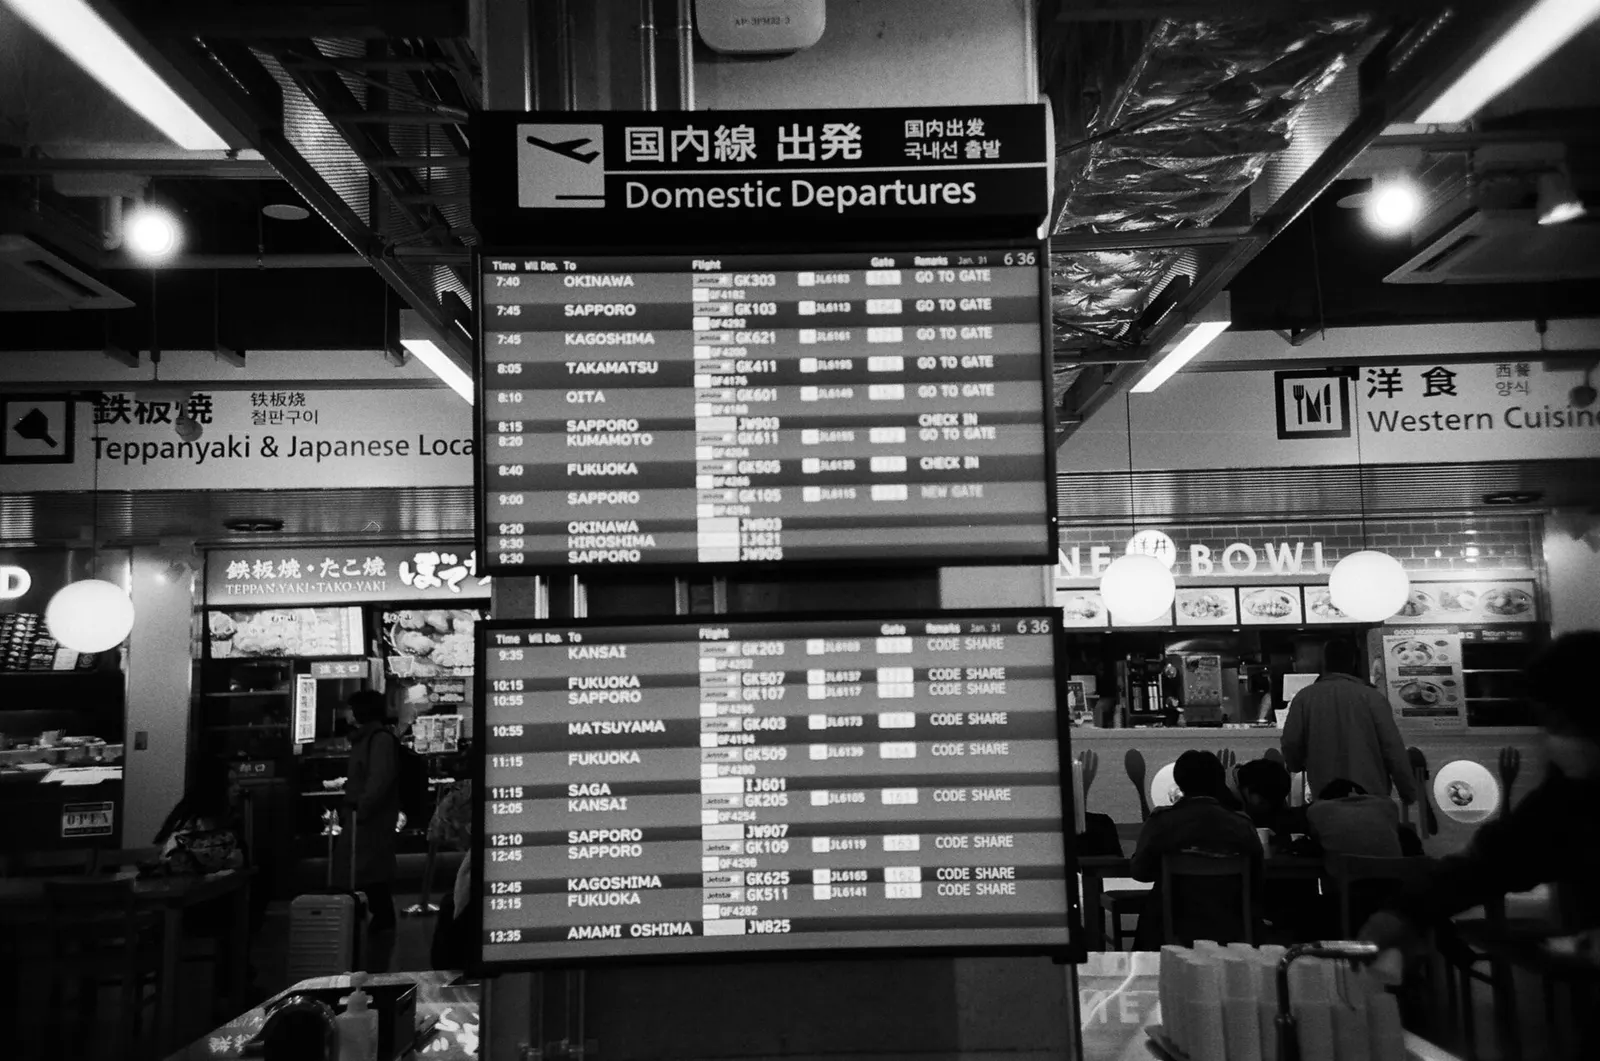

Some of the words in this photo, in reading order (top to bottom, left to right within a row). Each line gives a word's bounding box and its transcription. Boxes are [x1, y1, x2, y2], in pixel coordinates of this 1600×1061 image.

[904, 118, 985, 139] 国内出发
[625, 124, 757, 163] 国内線
[777, 121, 862, 162] 出発
[904, 140, 959, 161] 국내선
[964, 138, 1001, 160] 출발
[626, 180, 781, 208] Domestic
[791, 179, 977, 214] Departures
[563, 260, 577, 271] To
[496, 276, 520, 287] 7:40
[563, 276, 634, 287] OKINAWA
[915, 271, 934, 283] GO
[937, 270, 955, 282] TO
[959, 269, 991, 282] GATE
[497, 305, 521, 316] 7:45
[564, 304, 636, 316] SAPPORO
[735, 303, 777, 315] GK103
[916, 300, 935, 312] GO
[938, 299, 956, 312] TO
[960, 298, 992, 311] GATE
[497, 334, 521, 345] 7:45
[565, 333, 655, 345] KAGOSHIMA
[917, 328, 935, 340] GO
[939, 327, 957, 340] TO
[960, 327, 993, 339] GATE
[497, 363, 522, 374] 8:05
[566, 362, 658, 374] TAKAMATSU
[736, 360, 776, 373] GK411
[917, 357, 936, 369] GO
[940, 356, 958, 368] TO
[961, 355, 994, 368] GATE
[498, 392, 522, 403] 8:10
[566, 391, 605, 403] OITA
[918, 385, 936, 397] GO
[941, 384, 959, 397] TO
[962, 383, 995, 396] GATE
[1367, 366, 1458, 399] 洋食
[1495, 380, 1530, 396] 양식
[251, 391, 306, 408] 铁板烧
[251, 409, 319, 426] 철판구이
[498, 421, 523, 432] 8:15
[567, 419, 639, 432] SAPPORO
[919, 414, 958, 427] CHECK
[963, 413, 978, 426] IN
[1368, 410, 1493, 433] Western
[498, 436, 523, 447] 8:20
[567, 434, 653, 446] KUMAMOTO
[919, 428, 938, 440] GO
[943, 427, 960, 440] TO
[964, 427, 996, 440] GATE
[91, 434, 250, 466] Teppanyaki
[260, 436, 278, 457] &
[287, 435, 410, 463] Japanese
[498, 465, 524, 476] 8:40
[568, 463, 638, 475] FUKUOKA
[920, 457, 960, 470] CHECK
[964, 456, 979, 469] IN
[499, 494, 524, 505] 9:00
[568, 492, 640, 504] SAPPORO
[499, 523, 524, 534] 9:20
[568, 521, 639, 533] OKINAWA
[499, 538, 524, 549] 9:30
[568, 535, 656, 548] HIROSHIMA
[499, 553, 524, 564] 9:30
[568, 550, 641, 563] SAPPORO
[1190, 541, 1332, 577] BOWL
[568, 632, 582, 643] To
[499, 650, 523, 661] 9:35
[568, 646, 627, 659] KANSAI
[927, 638, 960, 651] CODE
[965, 637, 1004, 650] SHARE
[493, 681, 523, 692] 10:15
[568, 676, 640, 690] FUKUOKA
[742, 672, 785, 686] GK507
[928, 668, 961, 681] CODE
[966, 667, 1005, 680] SHARE
[493, 695, 523, 706] 10:55
[568, 691, 641, 704] SAPPORO
[742, 686, 785, 700] GK107
[929, 683, 962, 696] CODE
[967, 682, 1006, 695] SHARE
[493, 726, 523, 737] 10:55
[568, 721, 665, 735] MATSUYAMA
[743, 717, 786, 730] GK403
[930, 713, 963, 726] CODE
[968, 712, 1007, 725] SHARE
[493, 757, 523, 768] 11:15
[569, 751, 640, 765] FUKUOKA
[744, 747, 787, 761] GK509
[932, 743, 964, 756] CODE
[970, 742, 1009, 755] SHARE
[492, 788, 523, 799] 11:15
[568, 783, 611, 797] SAGA
[492, 803, 523, 814] 12:05
[568, 798, 627, 812] KANSAI
[745, 793, 788, 807] GK205
[933, 790, 967, 803] CODE
[971, 789, 1011, 802] SHARE
[492, 835, 522, 846] 12:10
[568, 829, 642, 844] SAPPORO
[746, 824, 788, 838] JW907
[491, 850, 522, 861] 12:45
[568, 844, 642, 859] SAPPORO
[745, 839, 789, 854] GK109
[935, 836, 969, 849] CODE
[974, 834, 1014, 848] SHARE
[491, 882, 521, 893] 12:45
[568, 875, 662, 891] KAGOSHIMA
[746, 871, 789, 885] GK625
[936, 868, 970, 881] CODE
[976, 866, 1015, 880] SHARE
[491, 898, 521, 910] 13:15
[568, 892, 641, 907] FUKUOKA
[747, 887, 788, 902] GK511
[937, 884, 971, 897] CODE
[976, 882, 1015, 896] SHARE
[490, 930, 521, 942] 13:35
[567, 925, 622, 940] AMAMI
[630, 921, 693, 937] OSHIMA
[748, 919, 790, 934] JW825
